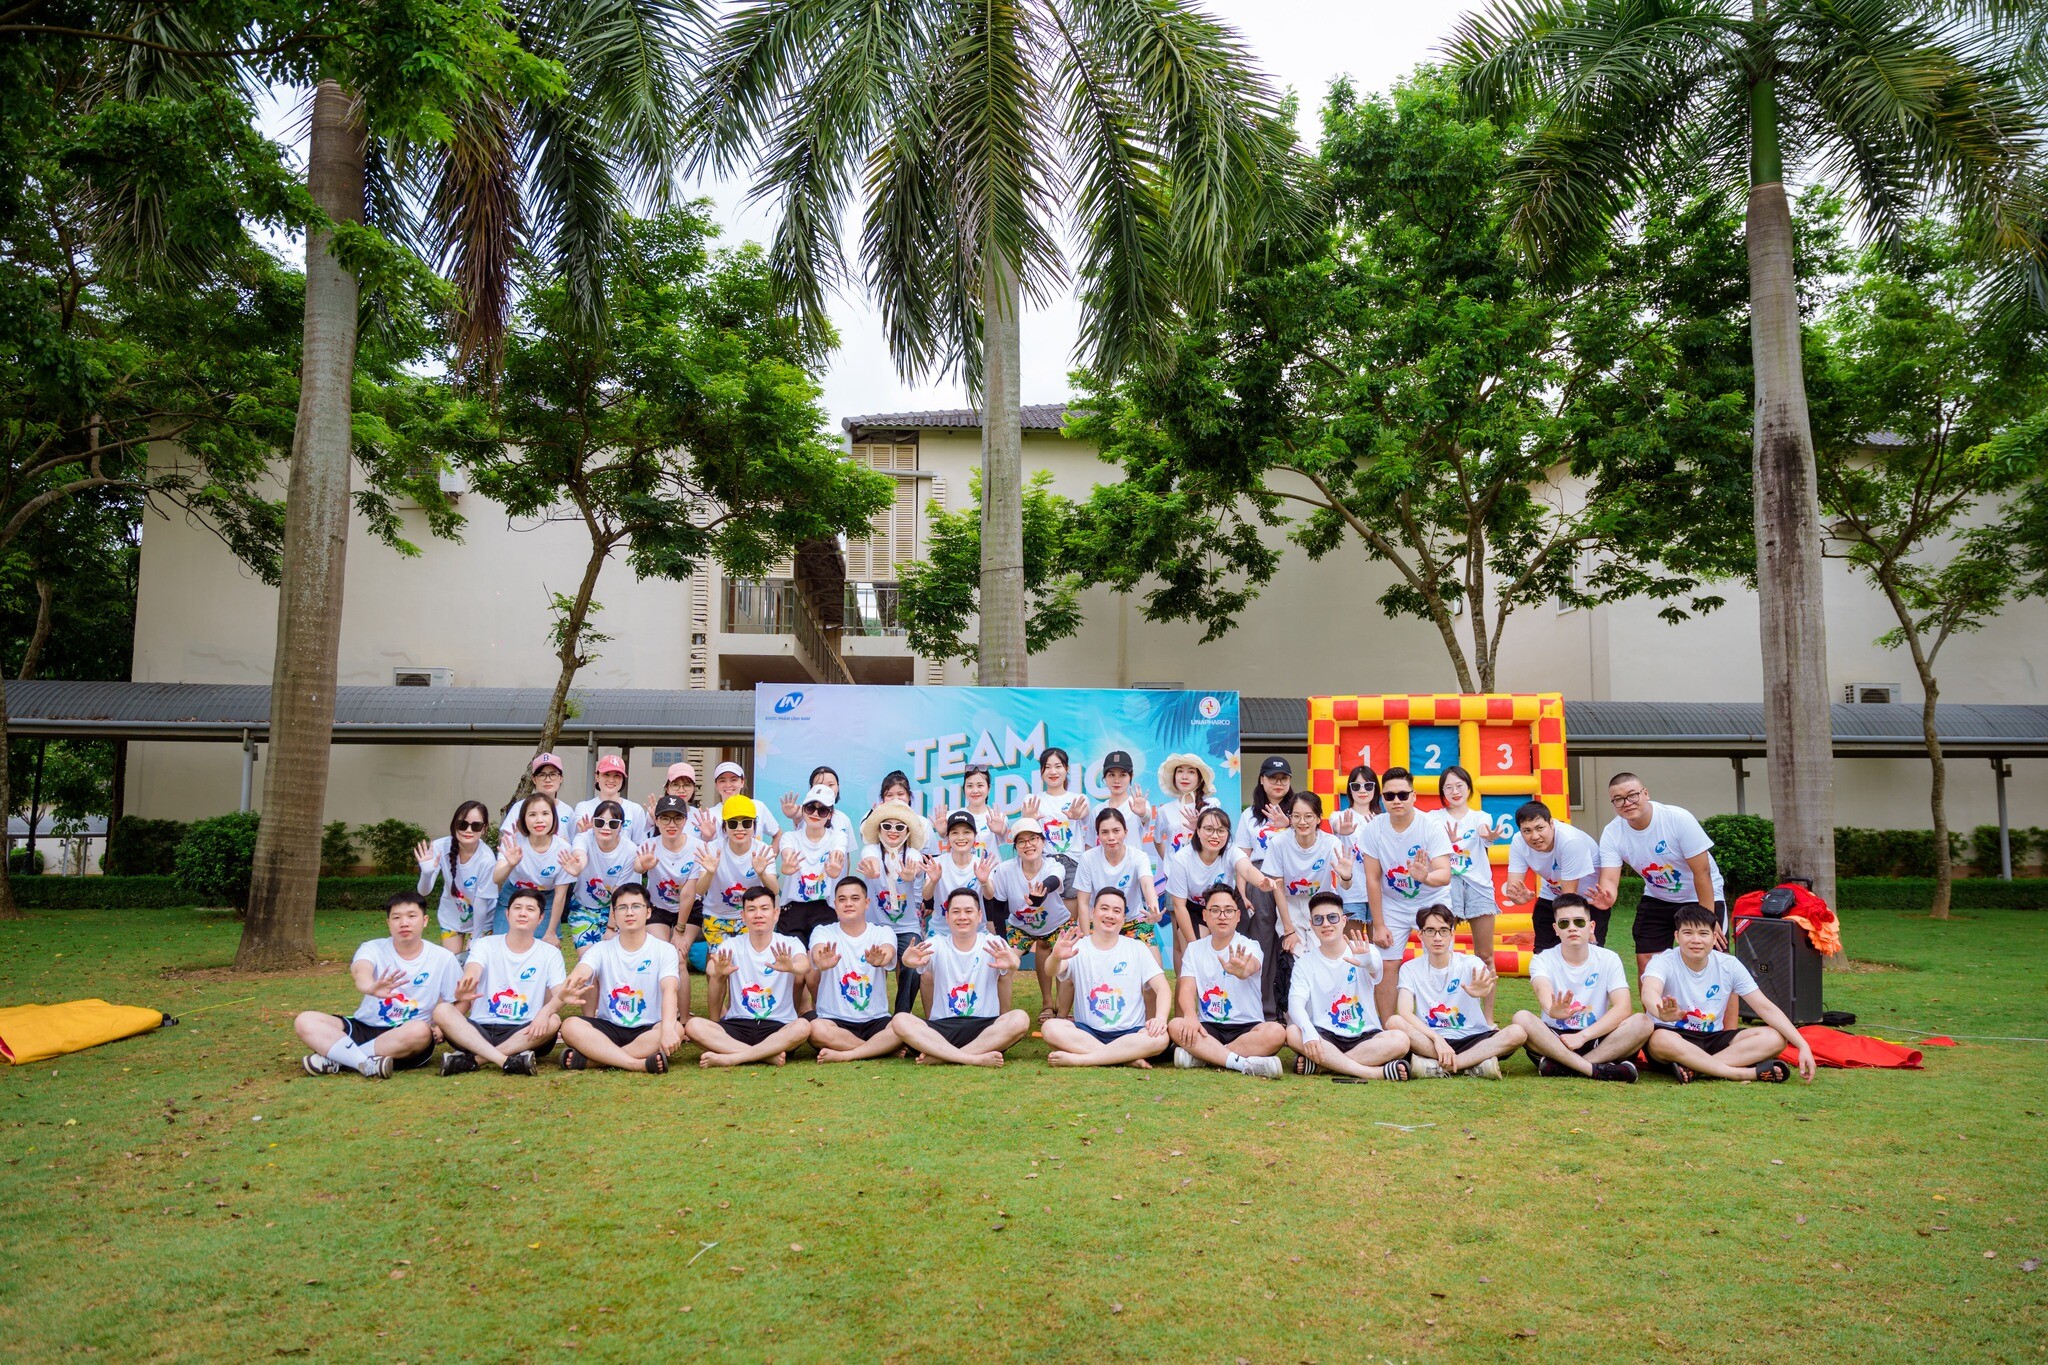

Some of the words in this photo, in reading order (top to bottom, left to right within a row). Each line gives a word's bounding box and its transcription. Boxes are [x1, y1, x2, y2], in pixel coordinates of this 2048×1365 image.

[905, 720, 1049, 784] TEAM
[1358, 745, 1371, 768] 1
[1424, 744, 1441, 770] 2
[1497, 743, 1514, 770] 3
[1497, 813, 1514, 839] 6
[402, 1006, 409, 1018] 1
[513, 1001, 518, 1016] 1
[630, 997, 635, 1013] 1
[1110, 995, 1115, 1010] 1
[1340, 1014, 1352, 1022] ARE
[1351, 1005, 1356, 1019] 1
